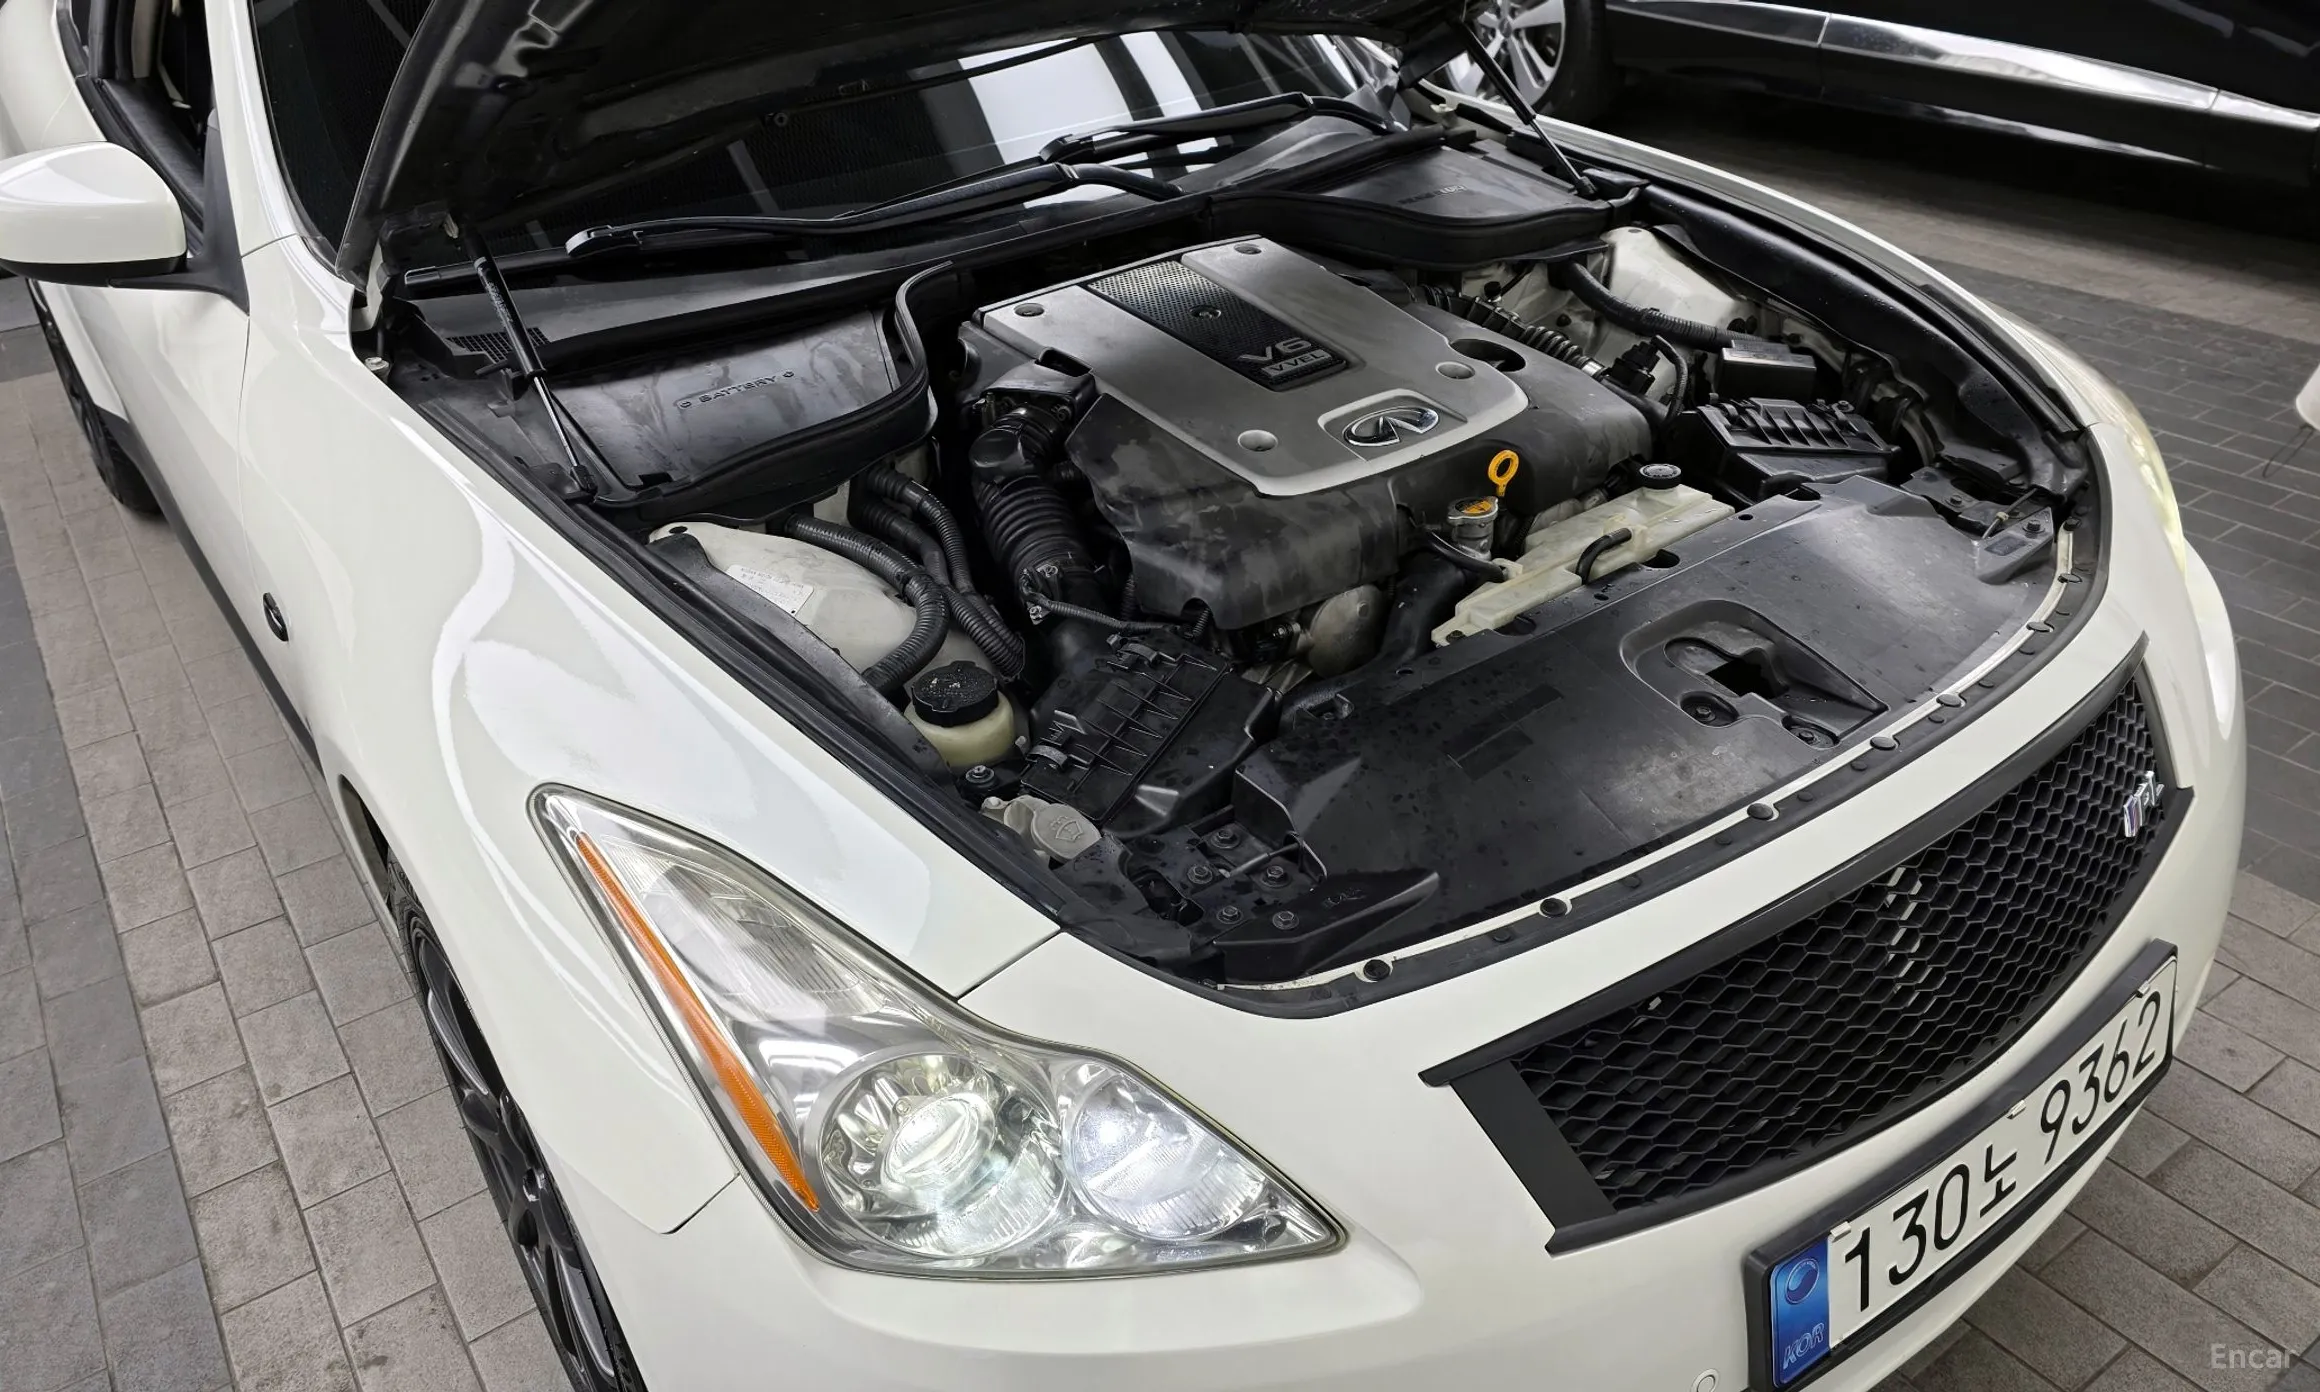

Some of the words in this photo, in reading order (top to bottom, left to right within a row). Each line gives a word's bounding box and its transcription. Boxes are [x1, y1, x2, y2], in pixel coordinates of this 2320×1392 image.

[1238, 337, 1312, 362] V6
[1268, 352, 1326, 372] VVEL
[698, 375, 777, 403] BATTERY
[1844, 1143, 2018, 1313] 130노
[2040, 991, 2161, 1166] 9362
[1782, 1322, 1825, 1370] KOR
